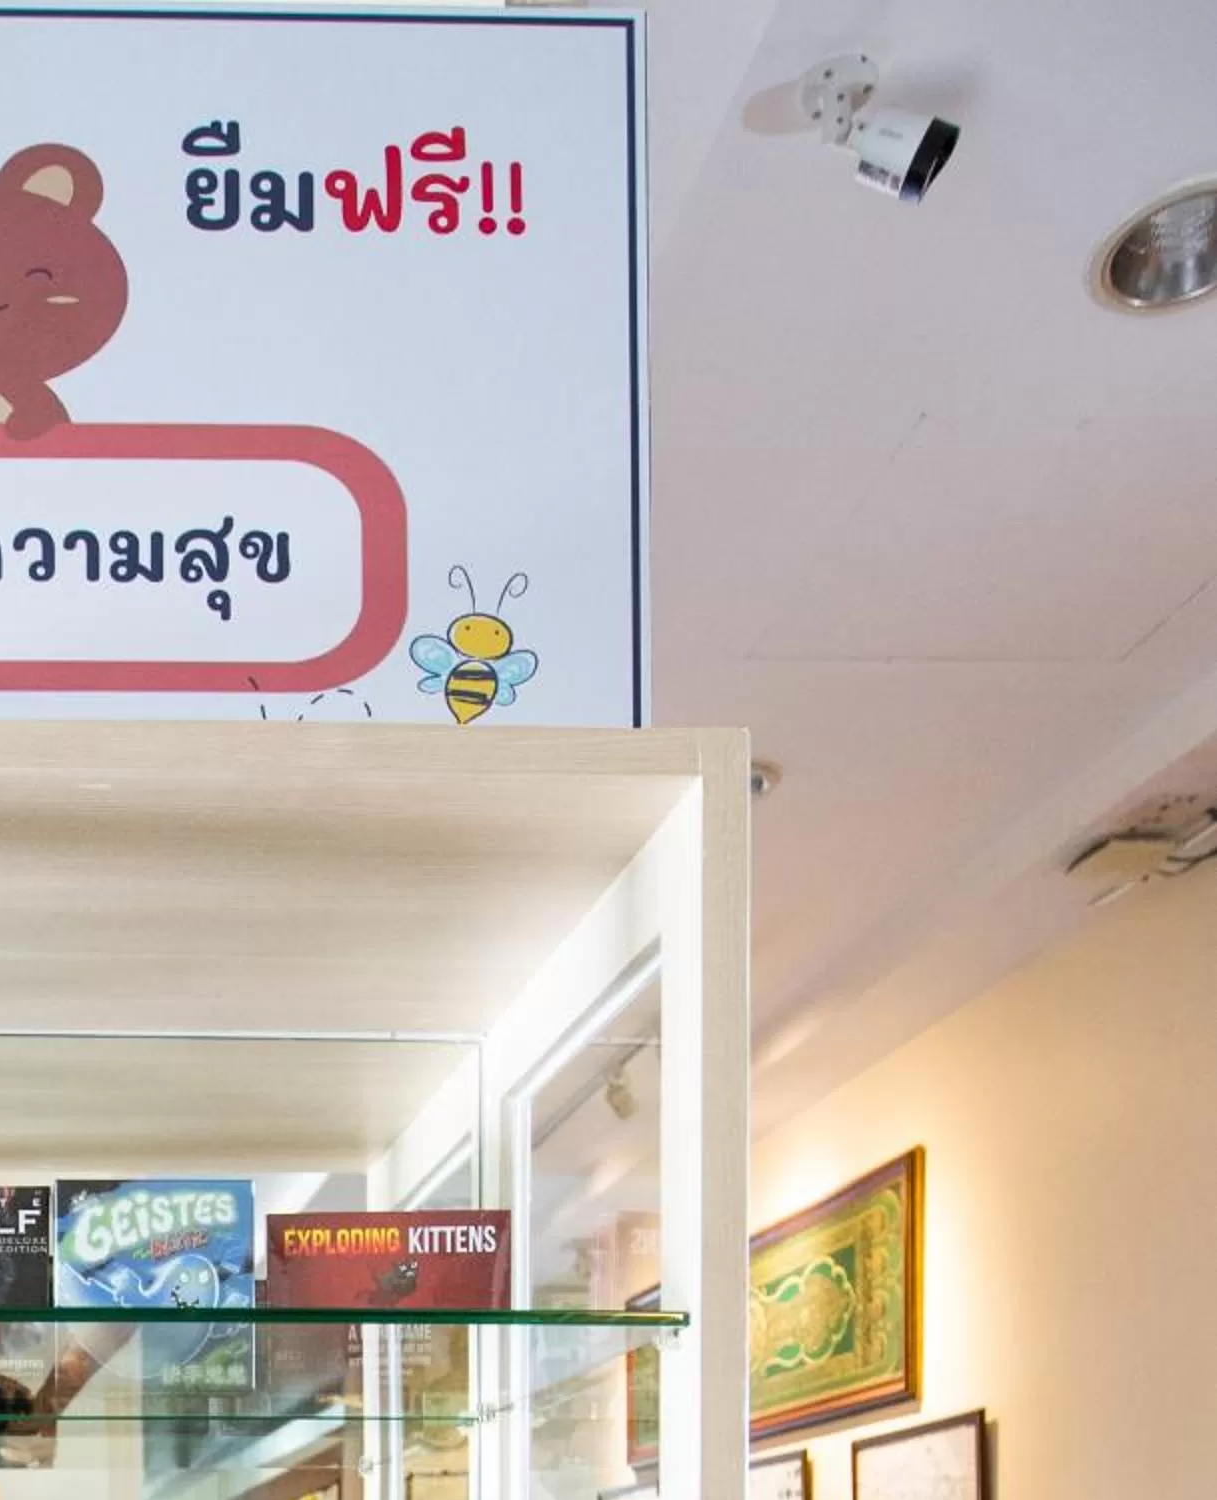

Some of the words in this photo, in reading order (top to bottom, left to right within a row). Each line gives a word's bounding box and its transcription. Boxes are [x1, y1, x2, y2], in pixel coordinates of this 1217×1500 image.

[181, 120, 526, 235] ยืมฟรี!!
[284, 1229, 400, 1255] EXPLODING
[408, 1226, 496, 1254] KITTENS
